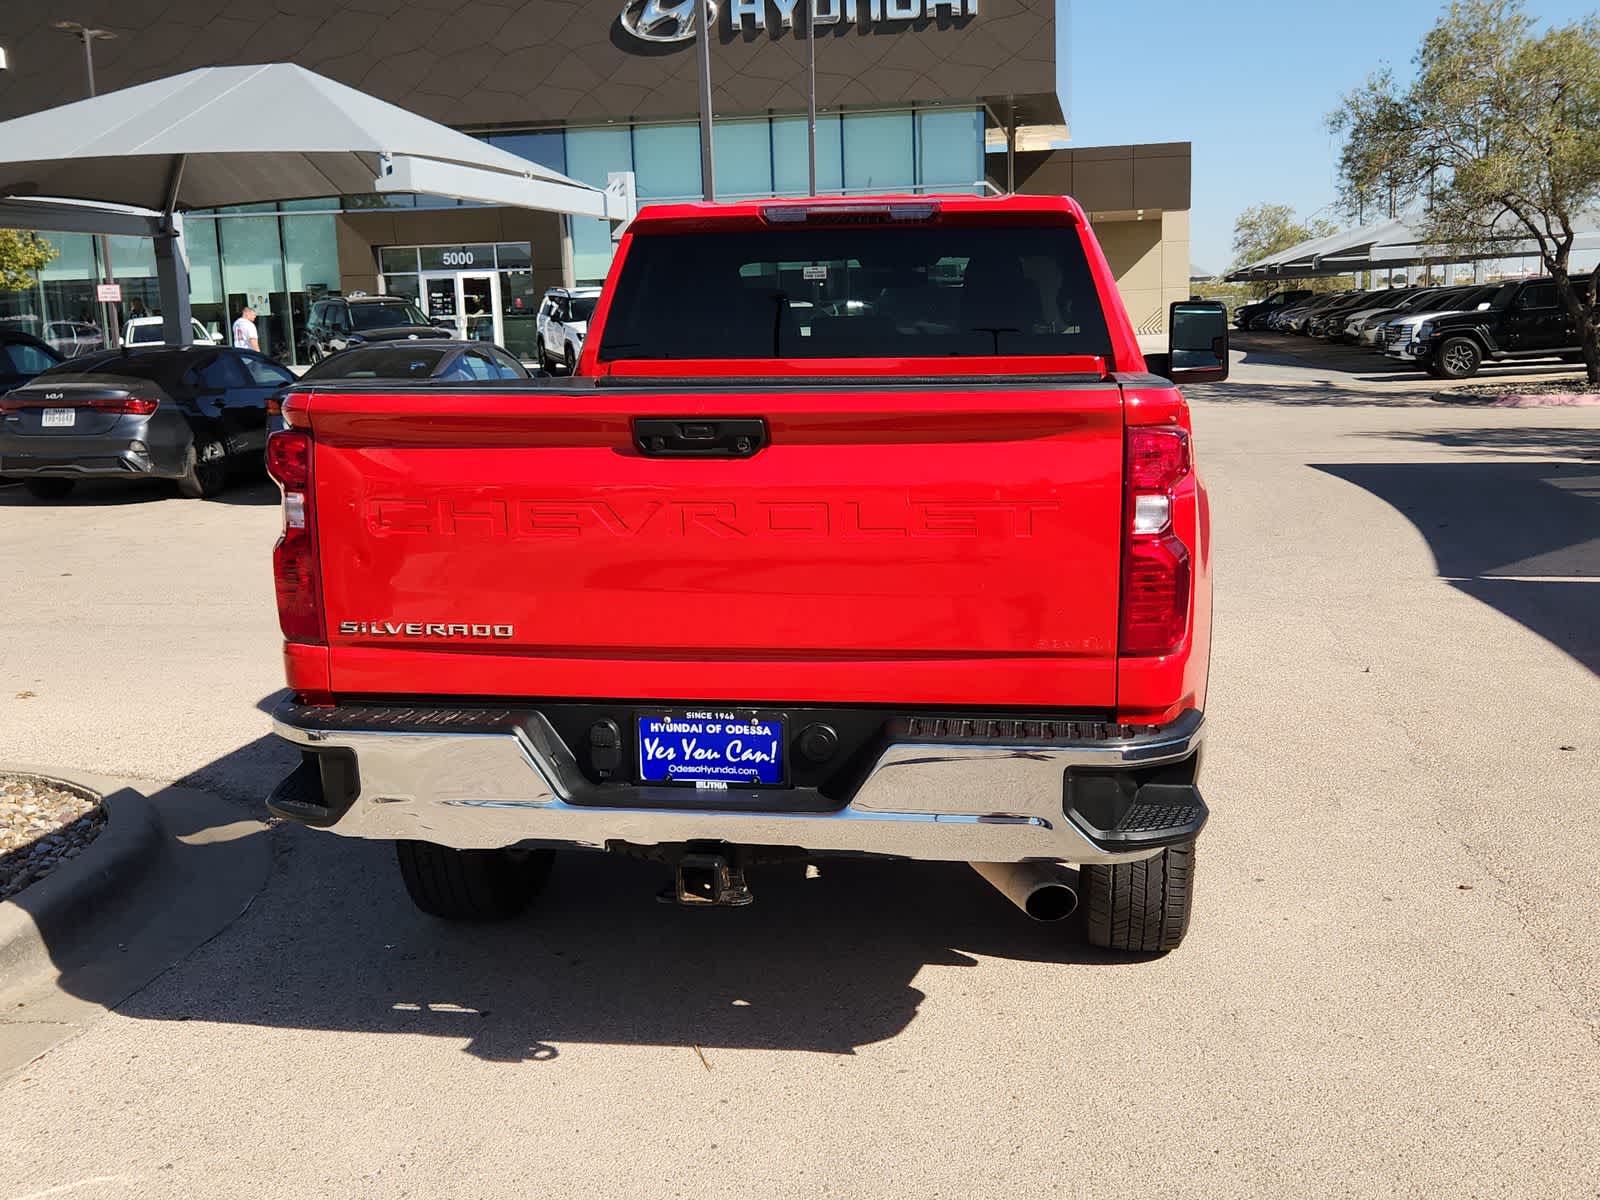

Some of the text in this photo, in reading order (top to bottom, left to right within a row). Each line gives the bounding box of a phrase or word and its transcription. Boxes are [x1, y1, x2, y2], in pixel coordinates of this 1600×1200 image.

[443, 252, 474, 265] 5000
[366, 497, 1060, 538] CHEVROLET
[340, 620, 514, 637] SILVERADO
[686, 711, 712, 720] SINCE
[650, 722, 772, 736] HYUNDAI OF ODESSA
[643, 737, 778, 764] Yes You Can!
[668, 764, 758, 775] OdessaHyundai.com
